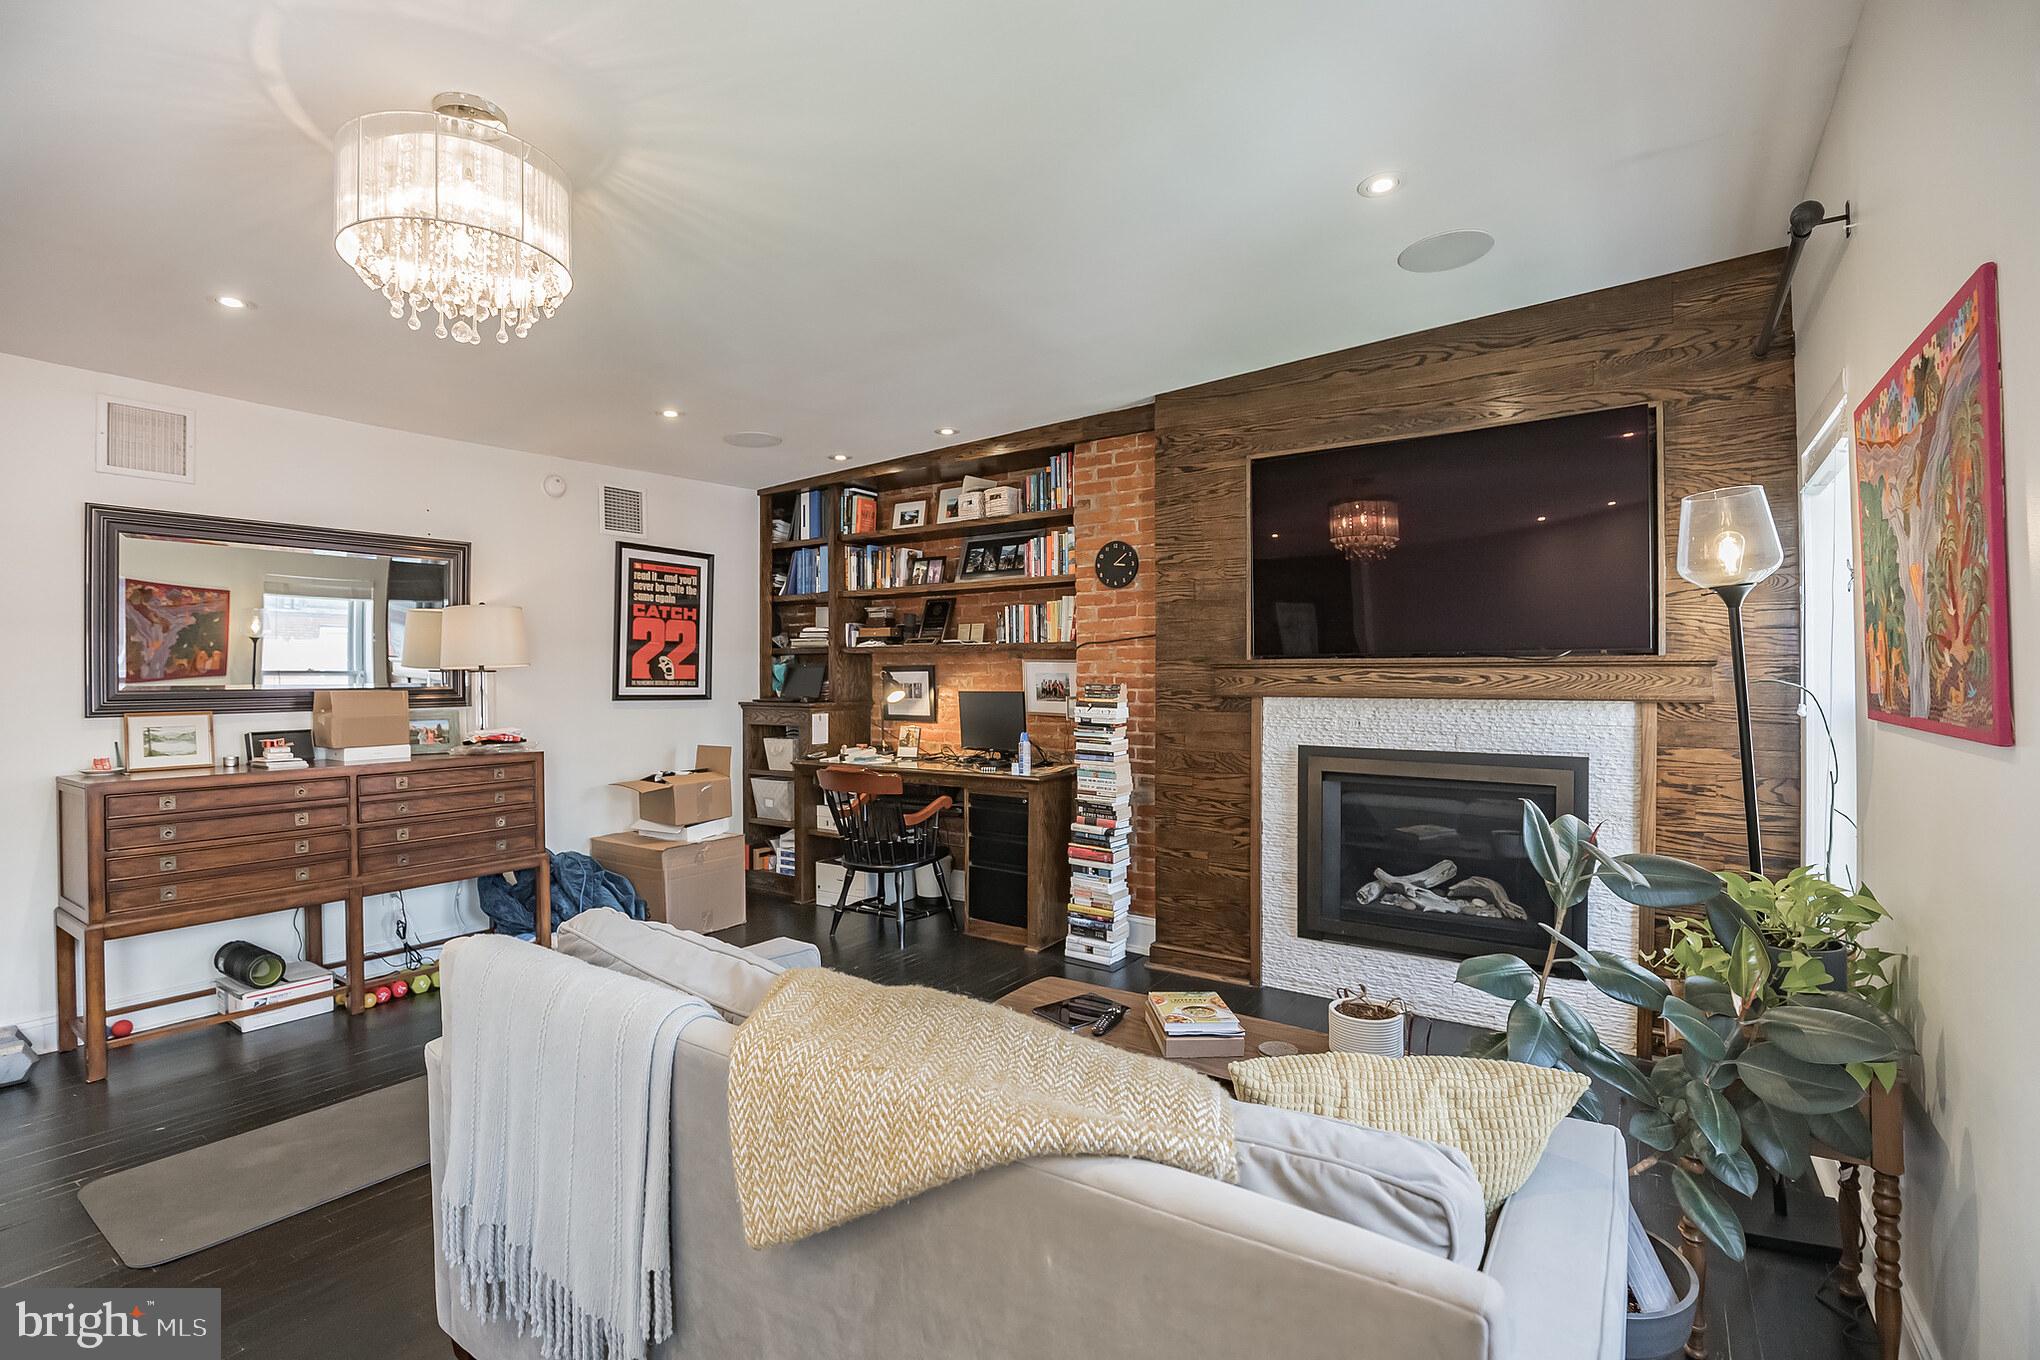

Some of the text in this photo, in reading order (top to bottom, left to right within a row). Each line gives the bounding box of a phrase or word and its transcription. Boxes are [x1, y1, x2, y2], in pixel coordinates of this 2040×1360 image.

[633, 571, 651, 581] read
[679, 575, 698, 586] you'll
[633, 582, 697, 596] never be quite the
[633, 593, 676, 604] same again
[632, 603, 697, 620] CATCH
[632, 617, 697, 680] 22
